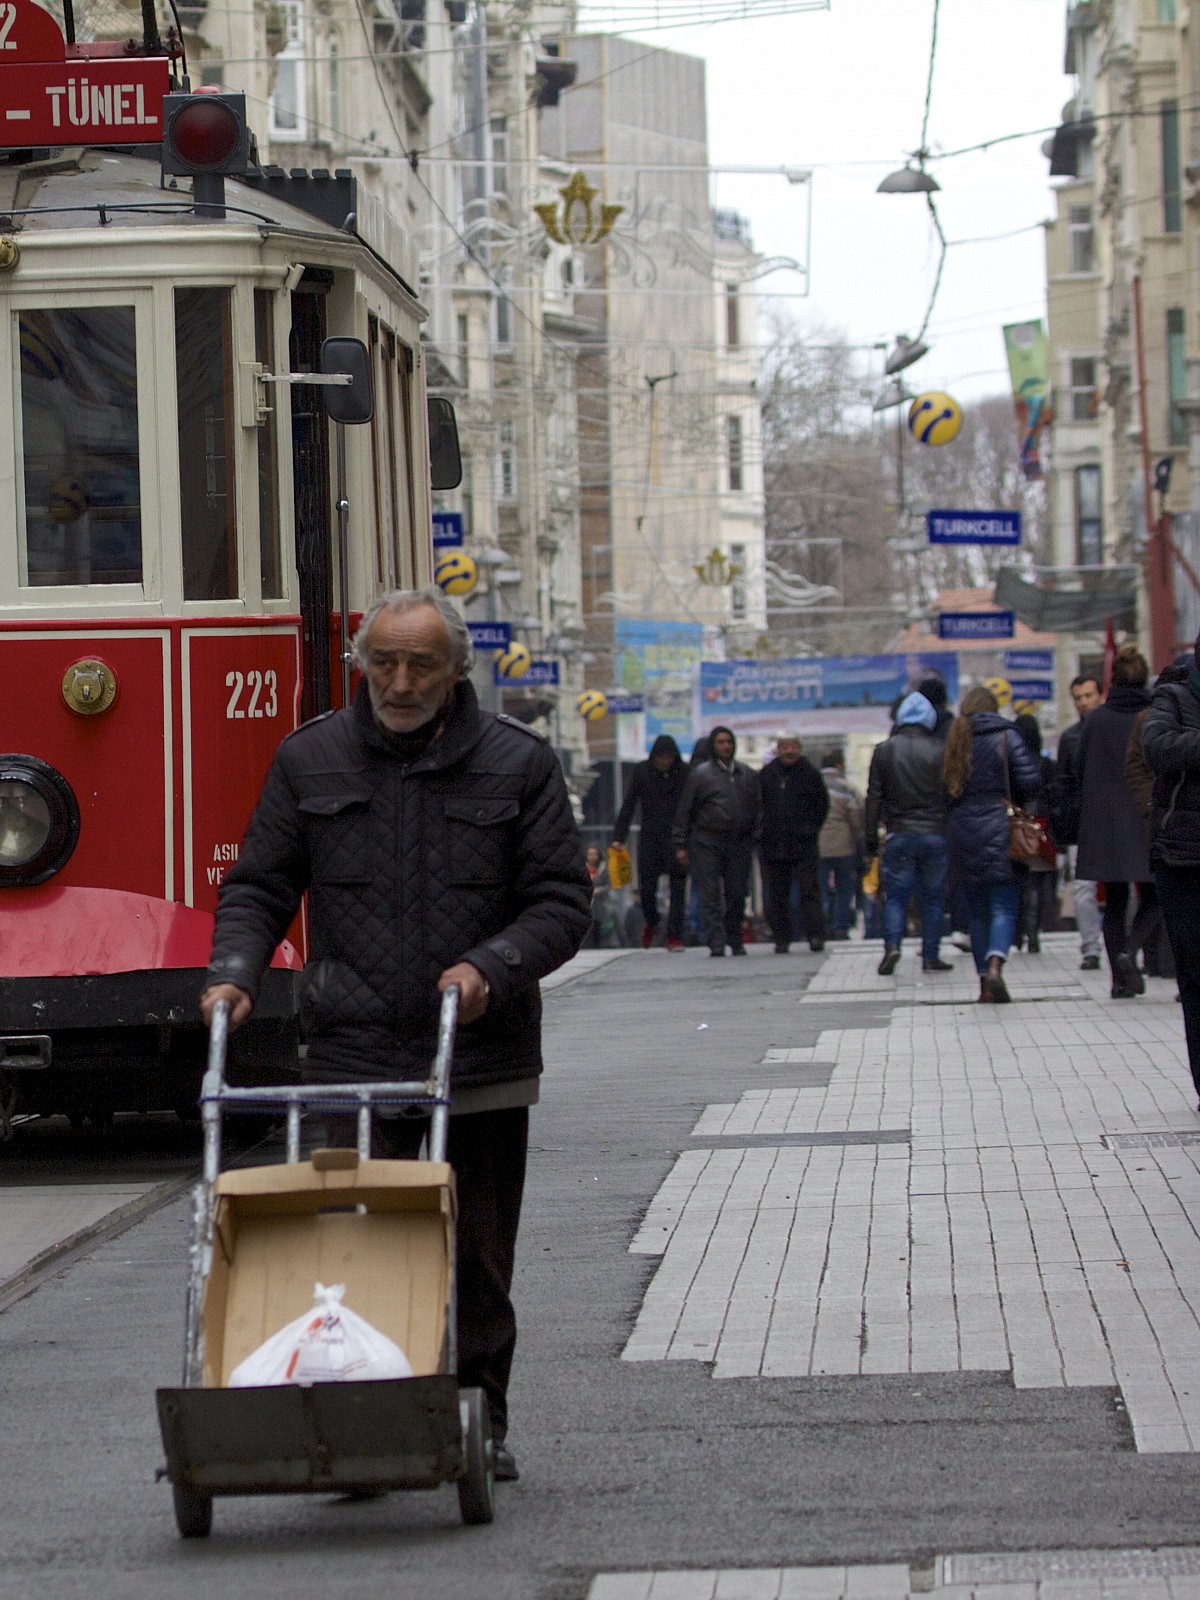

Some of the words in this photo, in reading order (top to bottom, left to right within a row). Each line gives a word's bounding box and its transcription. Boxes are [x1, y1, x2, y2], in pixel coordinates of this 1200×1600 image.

[45, 78, 158, 127] TÜNEL
[932, 518, 1018, 538] TURKCELL
[942, 617, 1011, 633] TURKCELL
[225, 669, 278, 719] 223
